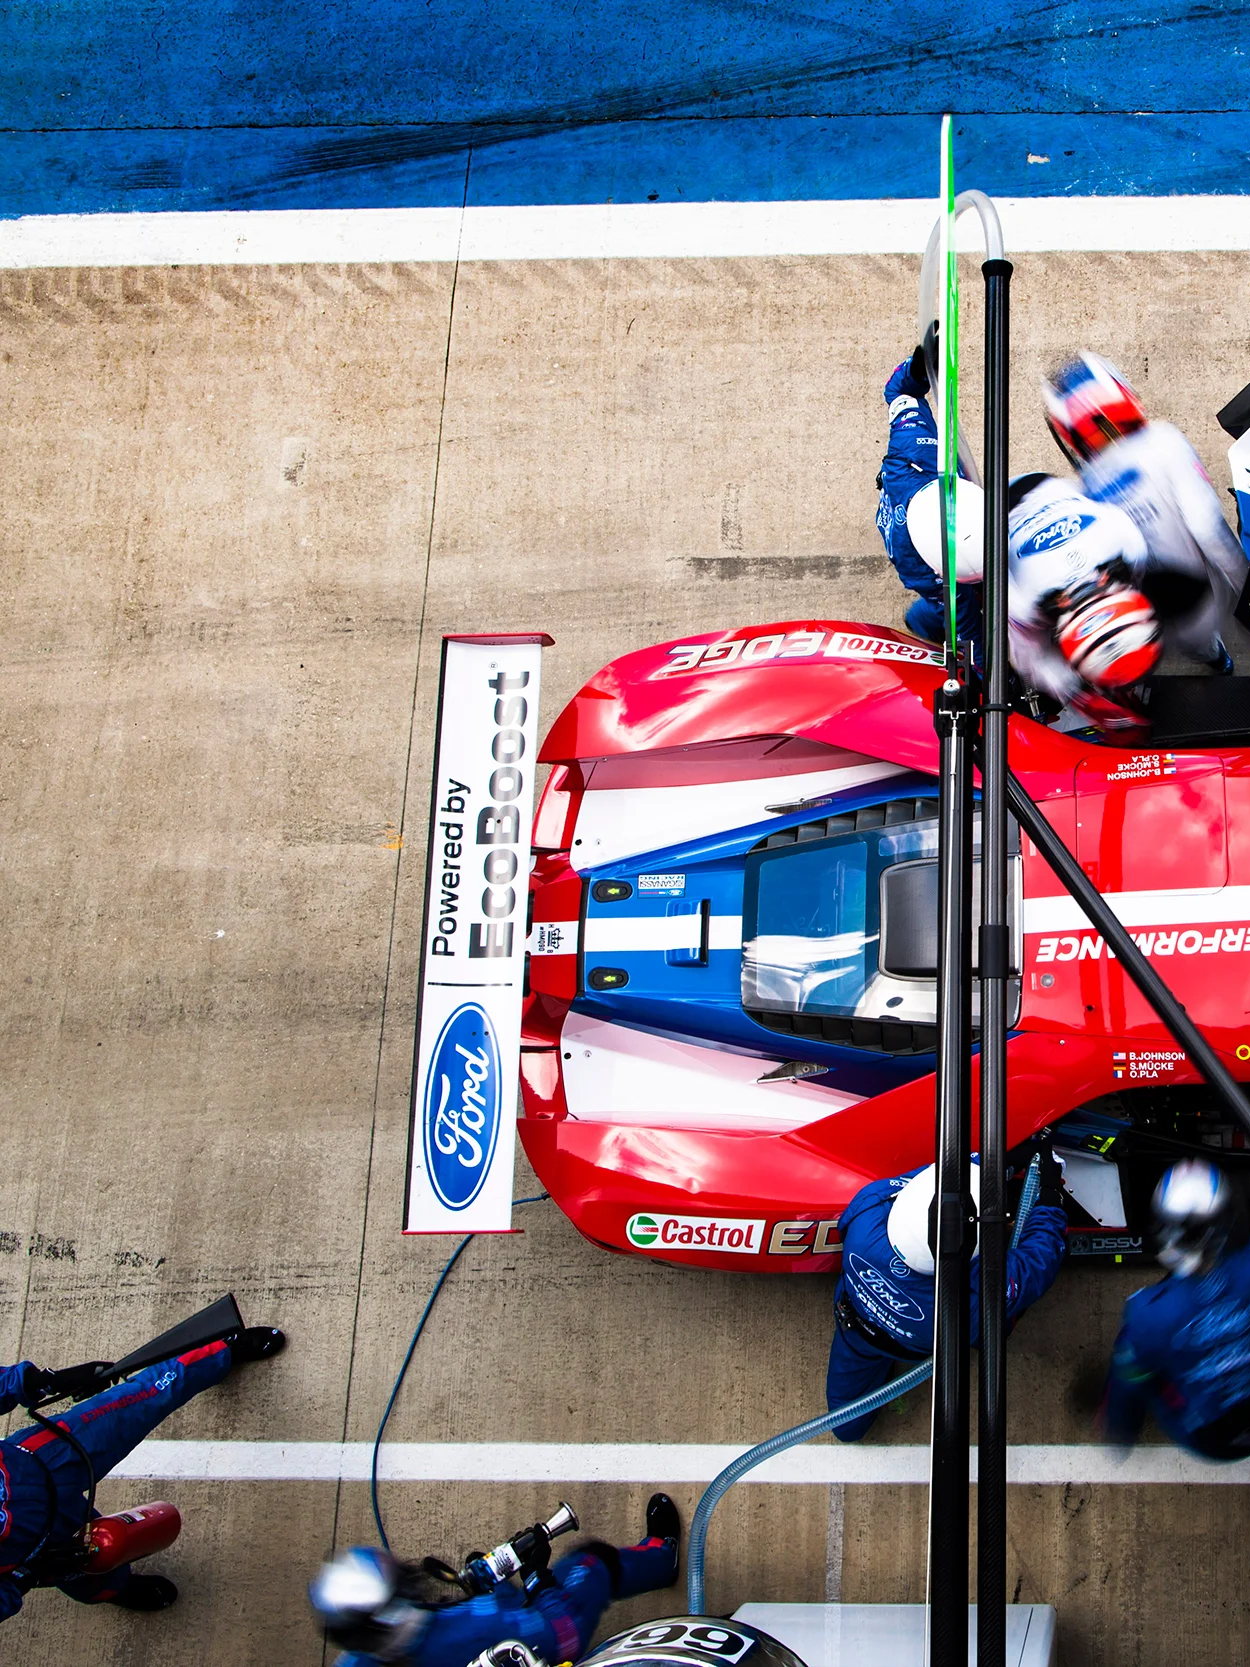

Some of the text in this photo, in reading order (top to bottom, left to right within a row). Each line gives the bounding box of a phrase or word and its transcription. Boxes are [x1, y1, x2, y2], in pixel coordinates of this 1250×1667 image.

[1033, 513, 1082, 549] Ford
[659, 631, 929, 674] Castrol EDGE
[1117, 760, 1160, 772] S.MÜCKE
[1131, 754, 1160, 763] O.PLA
[1106, 768, 1161, 781] B.JOHNSON
[468, 670, 530, 959] EcoBoost
[432, 778, 471, 957] Powered by
[1129, 1052, 1186, 1061] B.JOHNSON
[1129, 1061, 1174, 1070] S.MÜCKE
[1129, 1070, 1158, 1078] O.PLA
[434, 1045, 487, 1169] Ford
[660, 1218, 754, 1249] Castrol
[1092, 1236, 1143, 1248] DSSV
[859, 1268, 910, 1313] Ford
